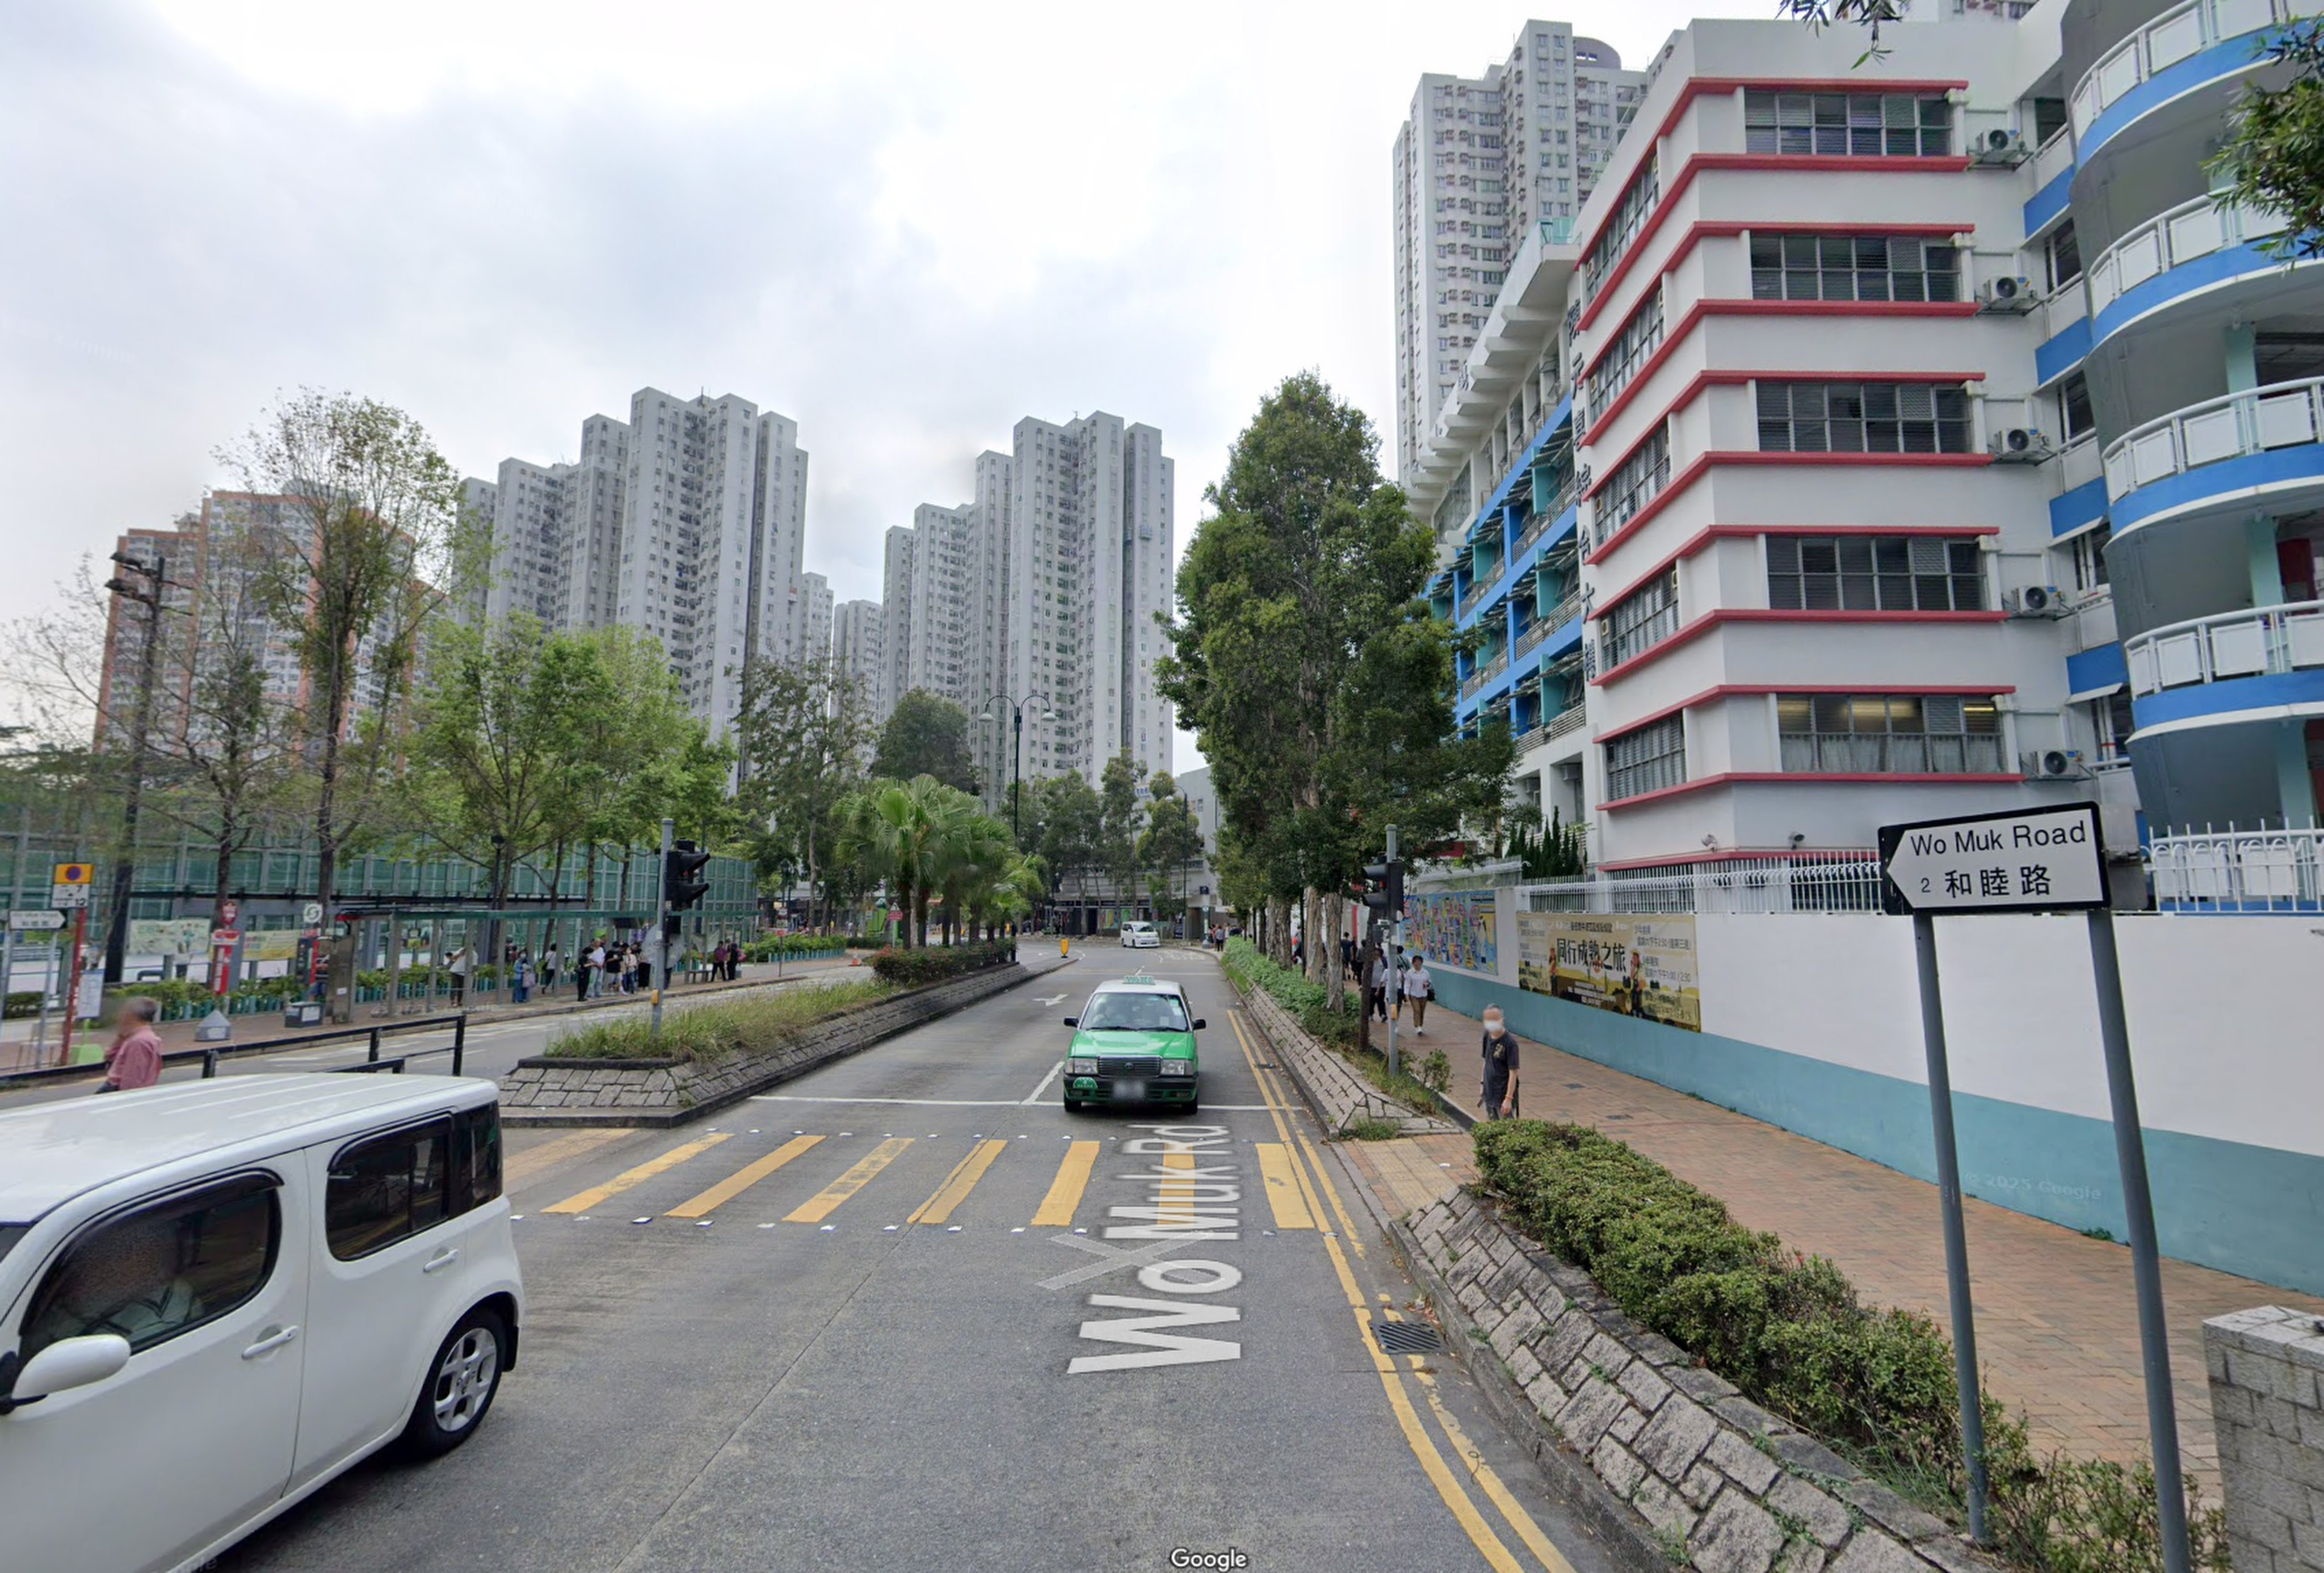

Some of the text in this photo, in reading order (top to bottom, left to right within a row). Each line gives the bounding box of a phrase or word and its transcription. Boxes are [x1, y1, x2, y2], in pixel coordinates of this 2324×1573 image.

[1910, 820, 2086, 856] Wo Muk Road
[1920, 864, 2051, 898] 2 和睦路
[1556, 938, 1627, 973] 同行成熟之旅
